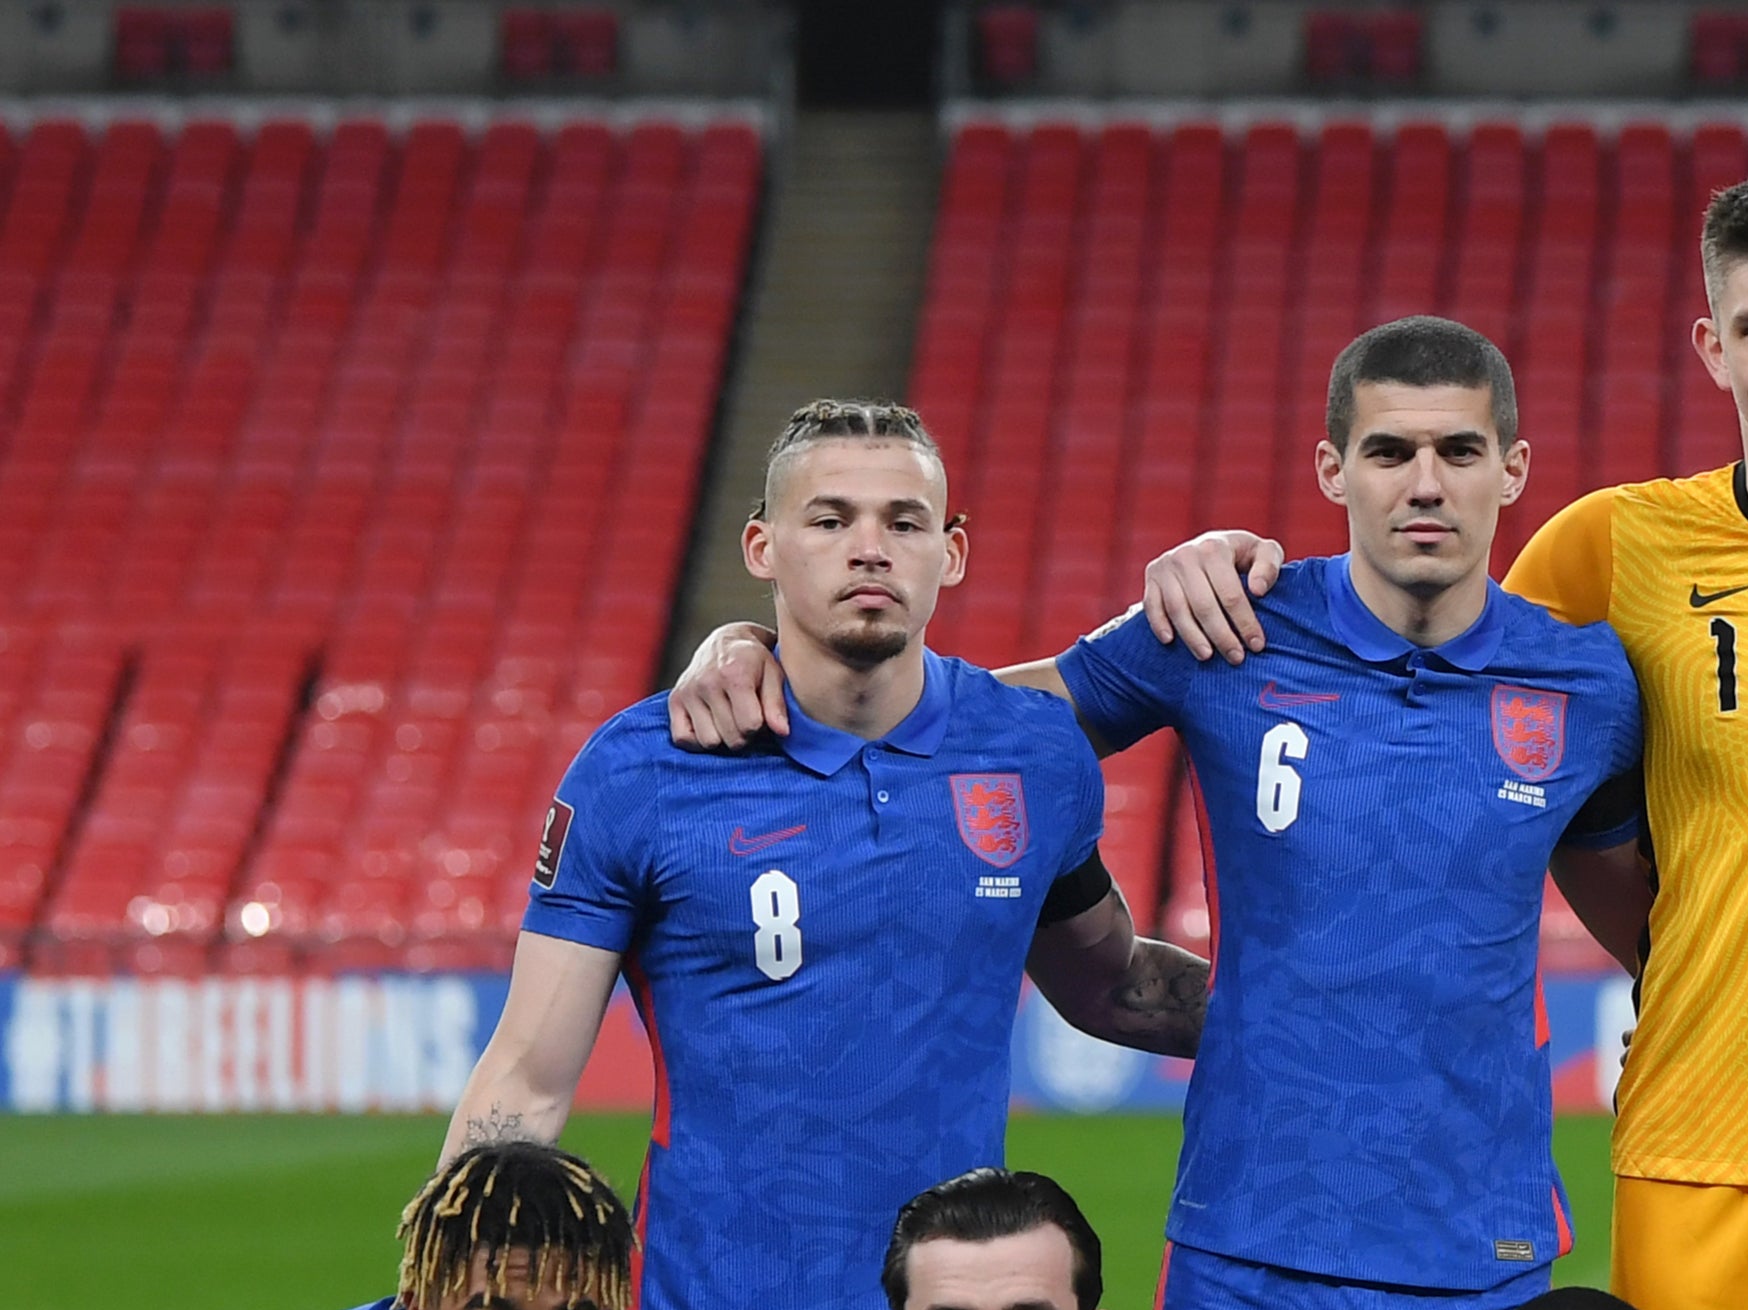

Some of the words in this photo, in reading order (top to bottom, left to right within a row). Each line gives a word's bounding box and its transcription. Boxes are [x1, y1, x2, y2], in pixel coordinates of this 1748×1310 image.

[1709, 616, 1738, 713] 1
[1256, 722, 1308, 832] 6
[750, 870, 803, 981] 8
